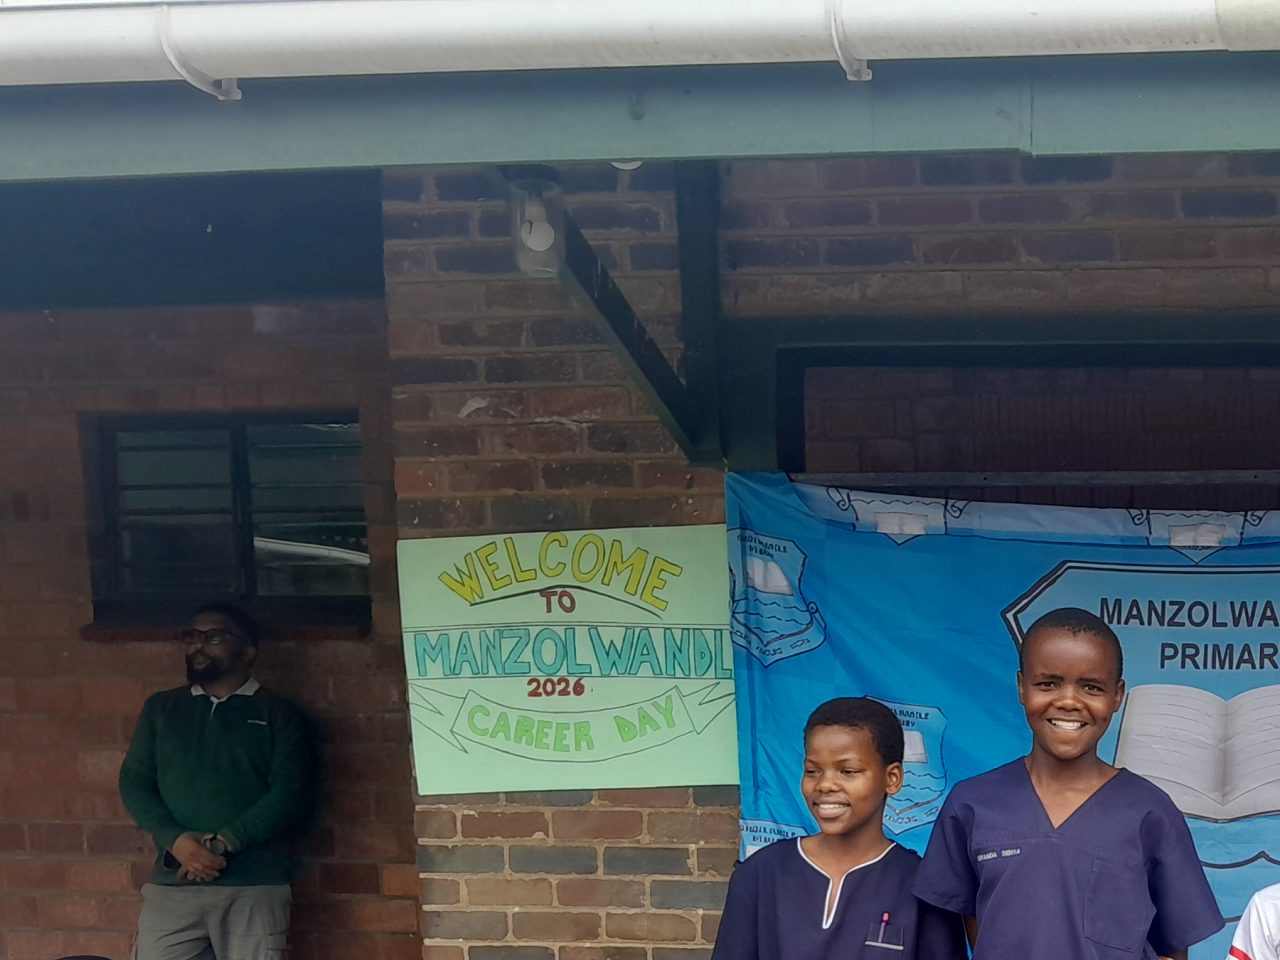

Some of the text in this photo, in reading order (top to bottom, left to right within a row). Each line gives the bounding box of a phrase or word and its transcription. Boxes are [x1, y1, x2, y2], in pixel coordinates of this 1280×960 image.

[438, 532, 683, 611] WELCOME
[539, 590, 576, 613] TO
[526, 678, 585, 697] 2026
[467, 695, 676, 752] CAREER DAY
